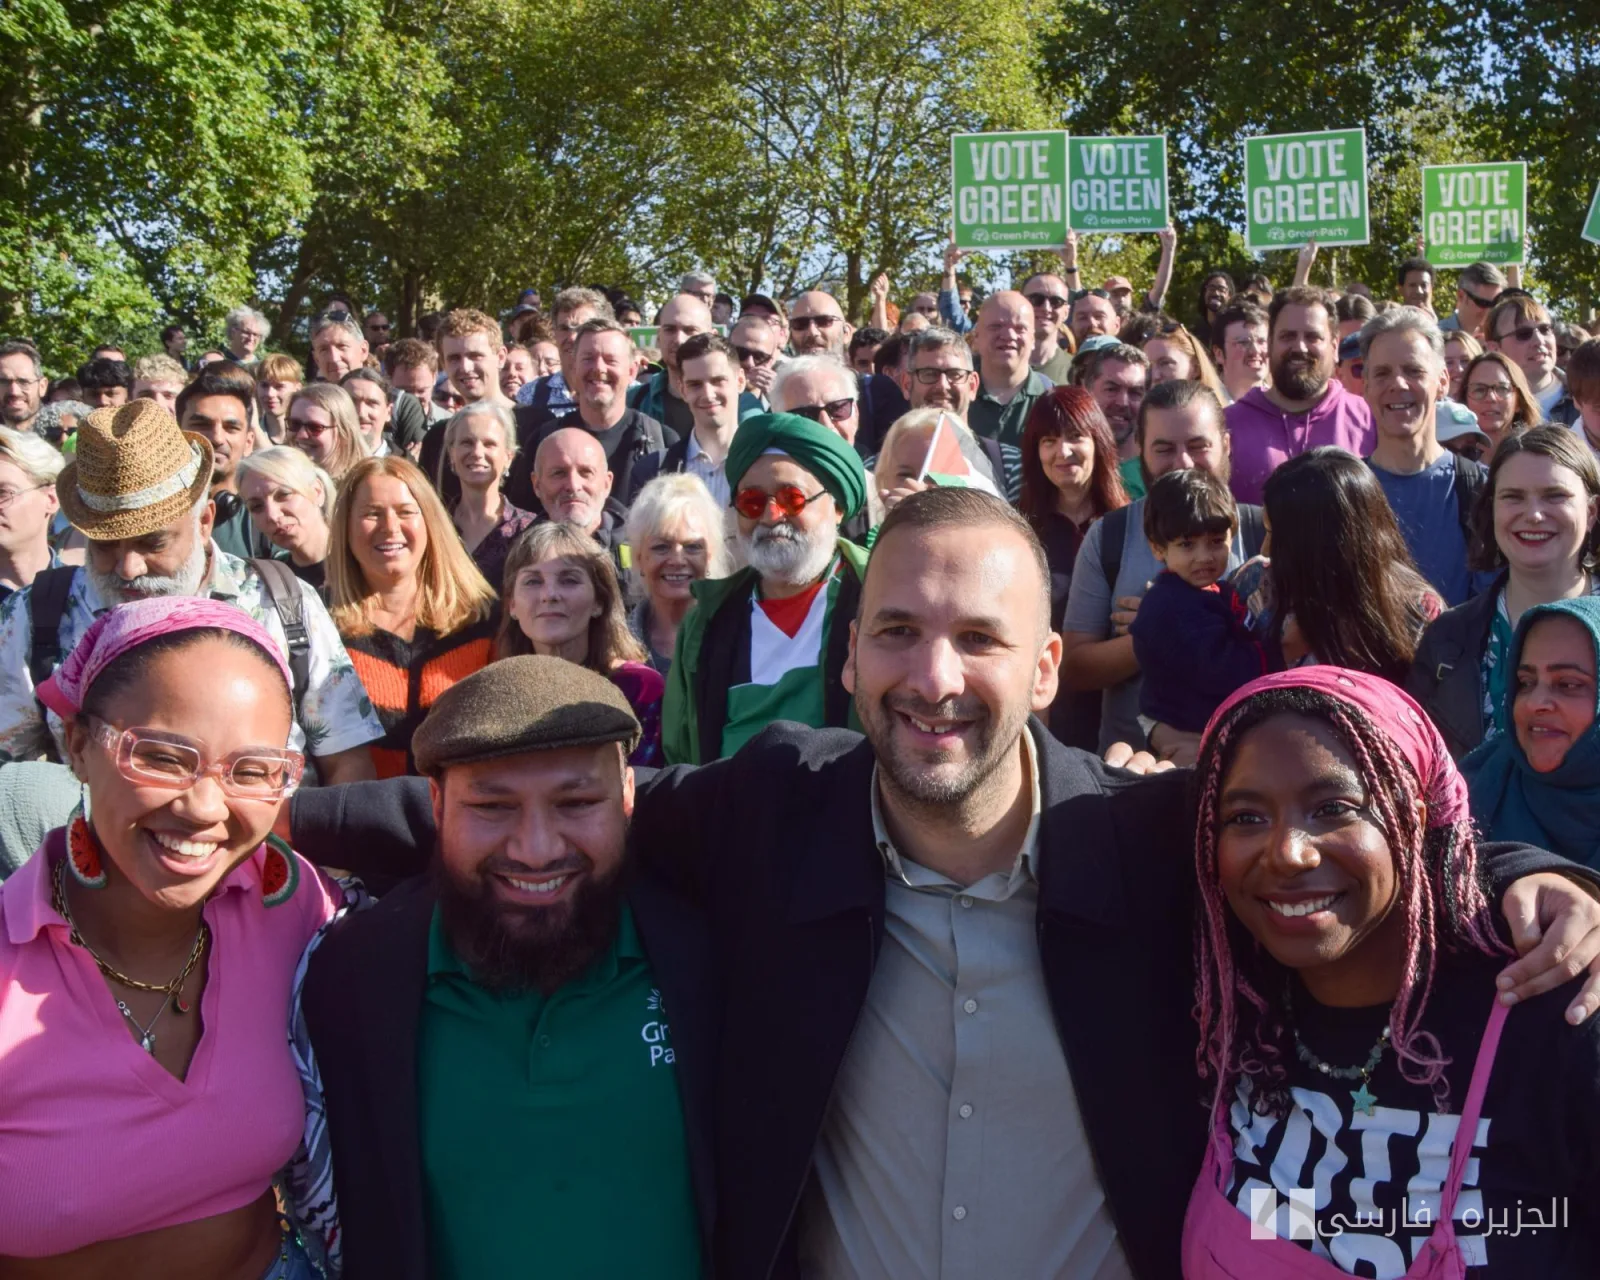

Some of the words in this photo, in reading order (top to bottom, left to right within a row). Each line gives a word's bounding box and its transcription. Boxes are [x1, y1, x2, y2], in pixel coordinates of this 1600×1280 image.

[969, 140, 1050, 181] VOTE
[1080, 143, 1151, 176] VOTE
[1263, 138, 1347, 182] VOTE
[959, 183, 1062, 225] GREEN
[1071, 178, 1161, 212] GREEN
[1253, 180, 1360, 225] GREEN
[1438, 170, 1509, 207] VOTE
[991, 231, 1022, 241] Green
[1023, 230, 1050, 242] Party
[1100, 216, 1127, 225] Green
[1128, 215, 1152, 226] Party
[1287, 228, 1317, 239] Green
[1320, 227, 1349, 238] Party
[1428, 208, 1519, 246] GREEN
[1456, 251, 1483, 260] Green
[1484, 250, 1509, 260] Party
[641, 1021, 671, 1042] Gr
